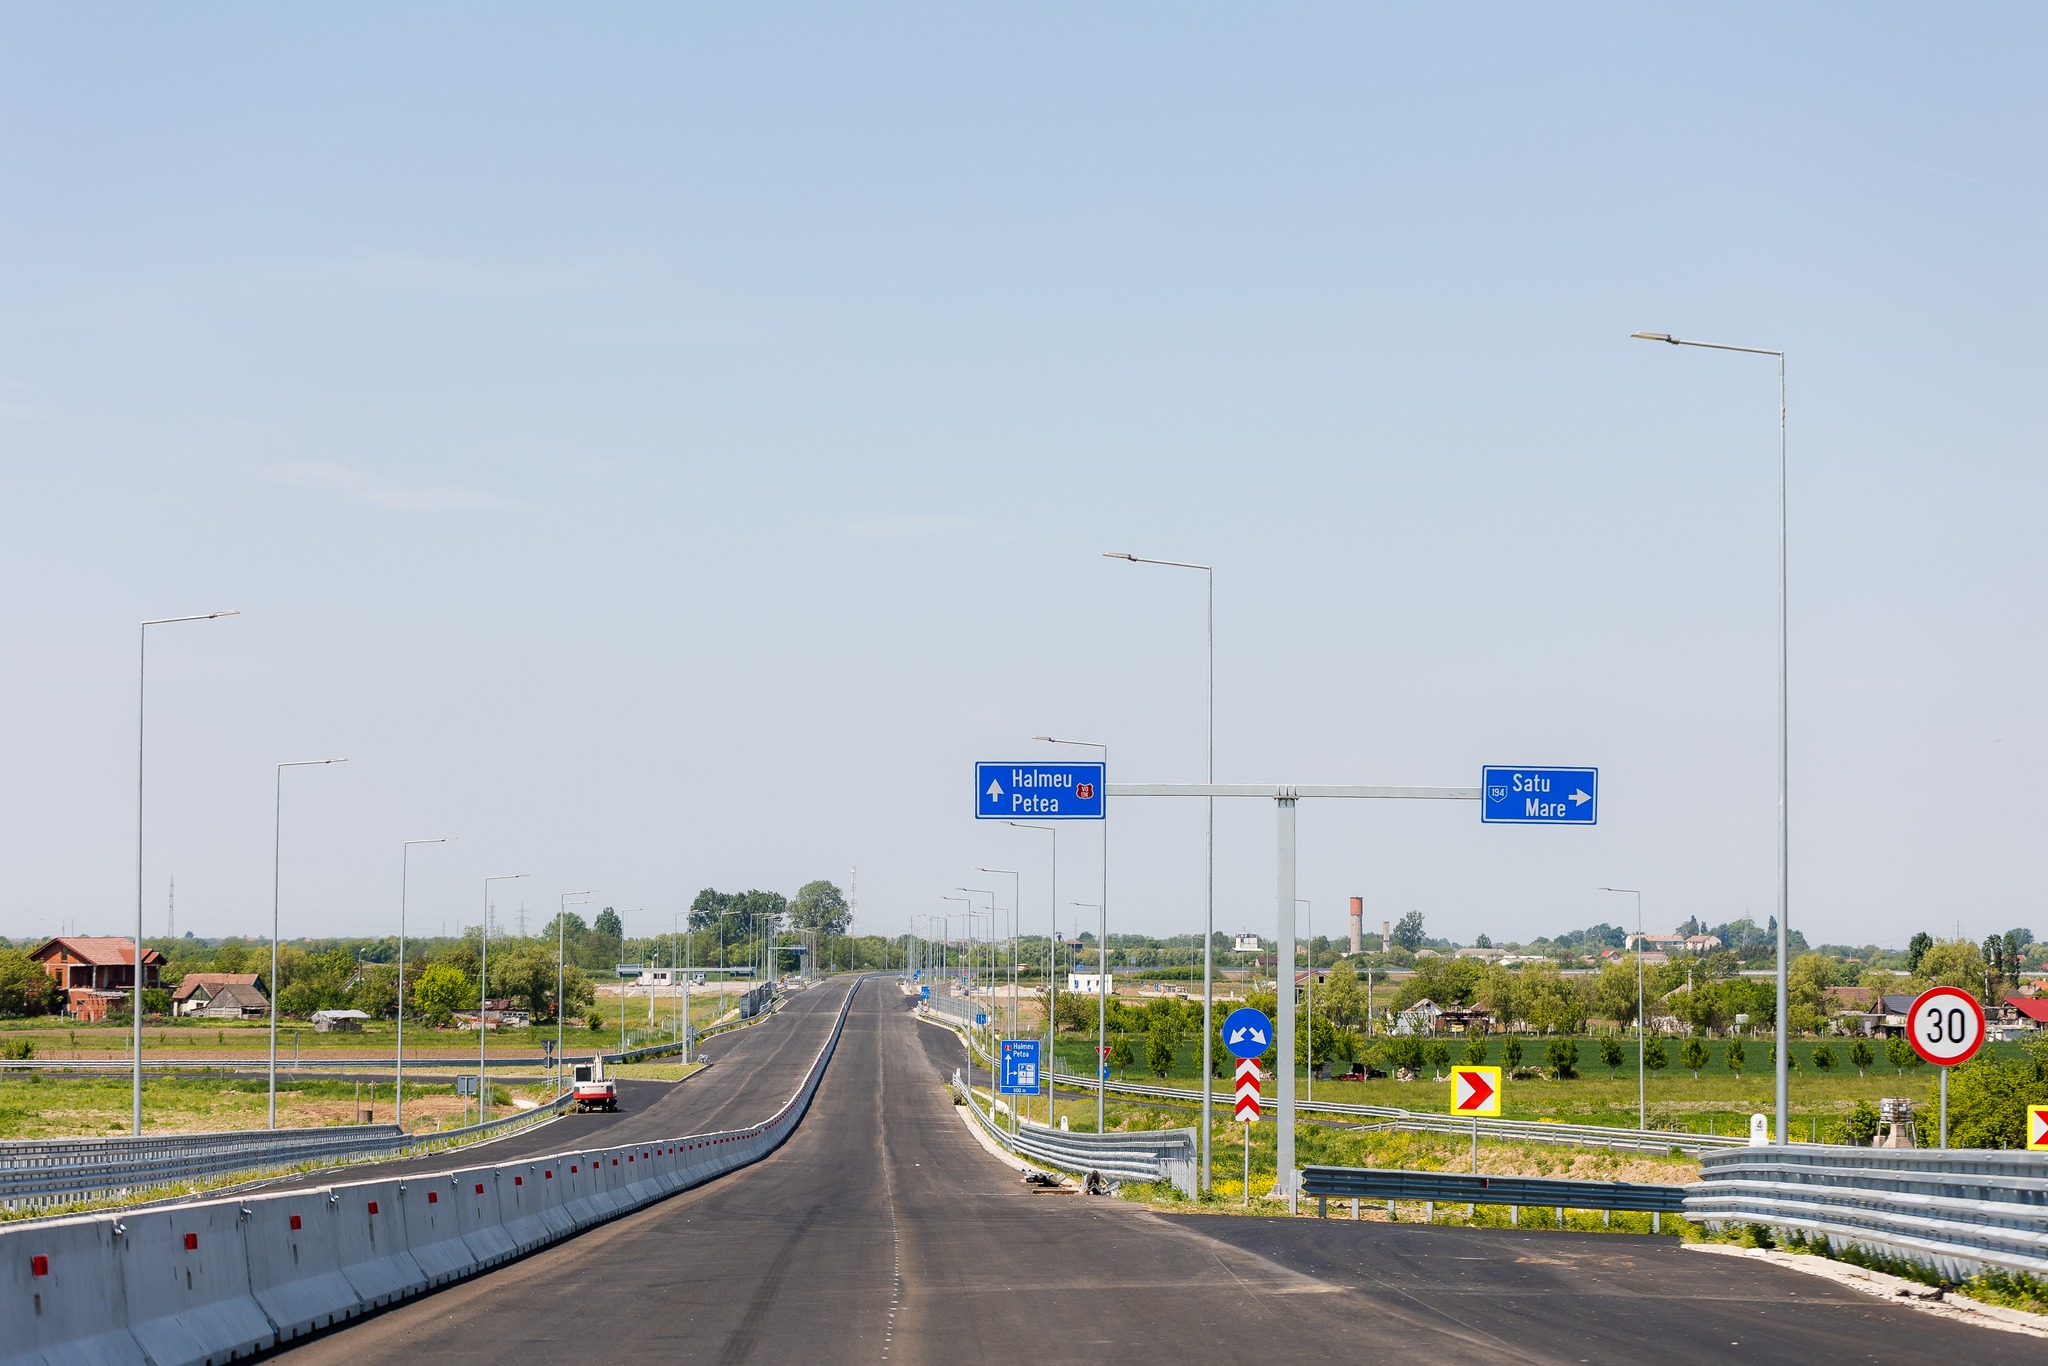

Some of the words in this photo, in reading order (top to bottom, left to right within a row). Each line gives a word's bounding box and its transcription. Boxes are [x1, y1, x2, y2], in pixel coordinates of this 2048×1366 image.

[1012, 769, 1072, 788] Halmeu
[1512, 773, 1550, 792] Satu
[1491, 788, 1505, 797] 194
[1012, 793, 1059, 812] Petea
[1525, 798, 1566, 817] Mare
[1926, 1007, 1965, 1044] 30
[1756, 1120, 1762, 1128] 4
